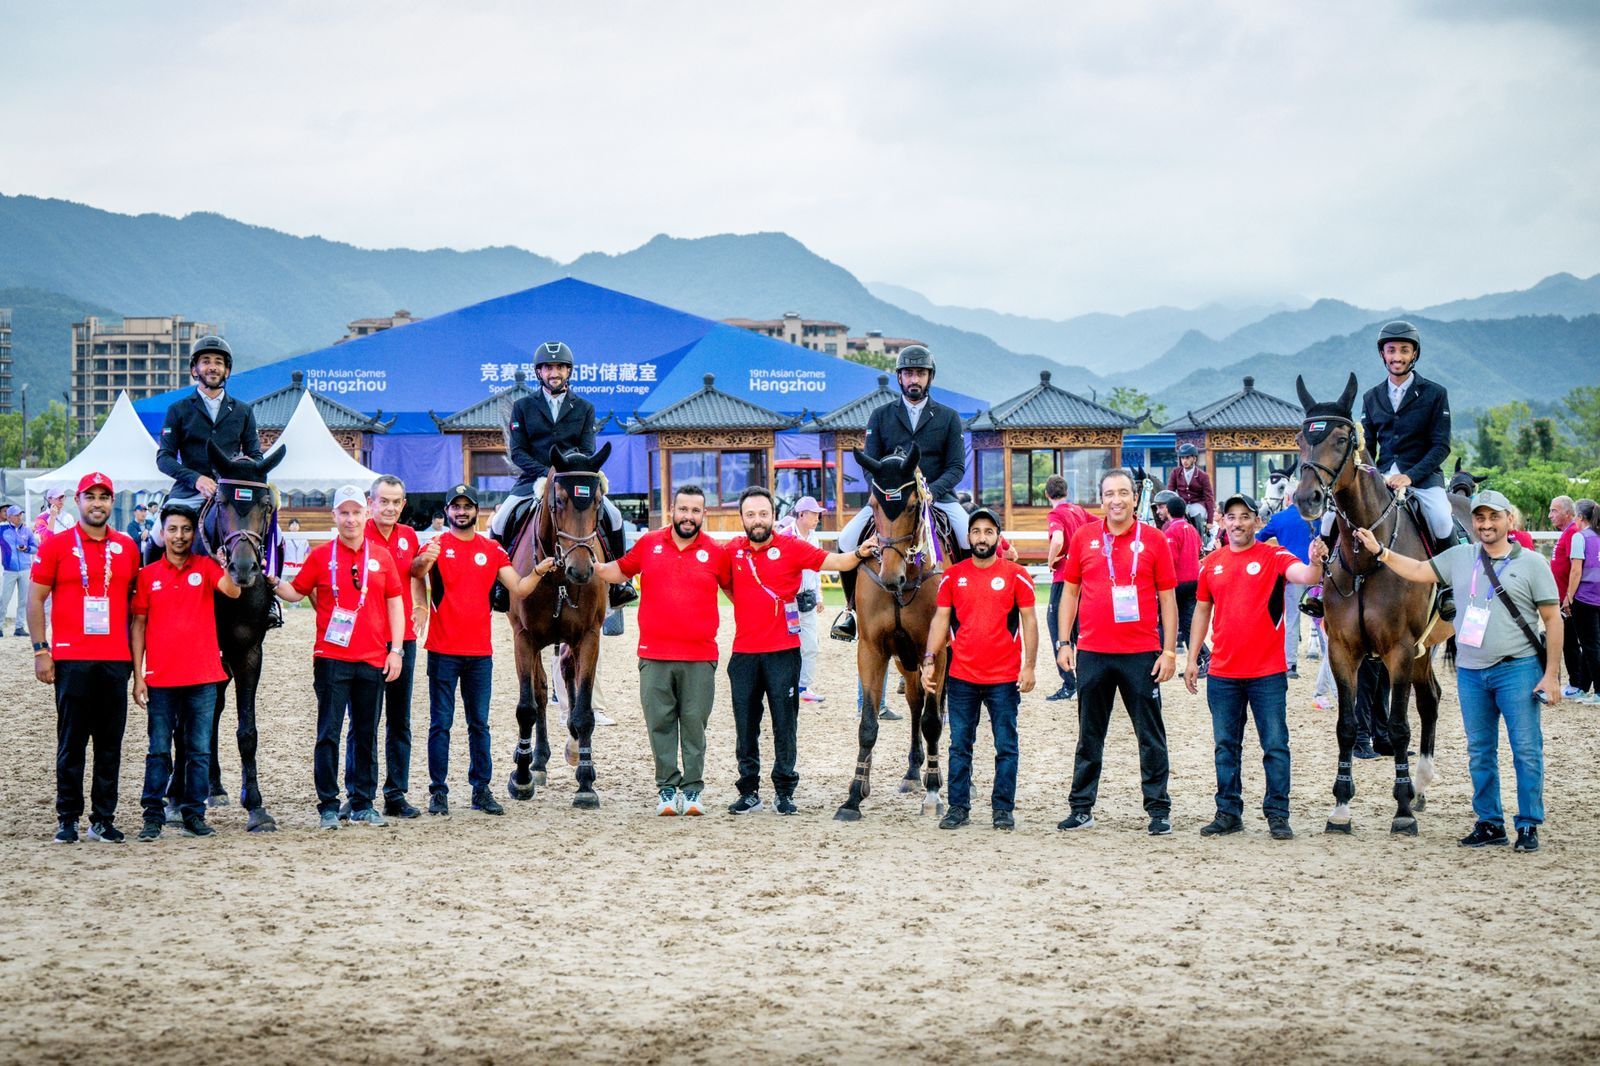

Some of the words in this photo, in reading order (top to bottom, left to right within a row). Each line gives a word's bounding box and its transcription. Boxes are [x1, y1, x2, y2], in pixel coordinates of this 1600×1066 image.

[306, 369, 326, 378] 19th
[328, 369, 353, 378] Asian
[355, 369, 386, 378] Games
[749, 369, 769, 378] 19th
[770, 369, 794, 378] Asian
[796, 369, 826, 378] Games
[307, 378, 386, 393] Hangzhou
[616, 385, 650, 395] Storage
[749, 378, 826, 393] Hangzhou
